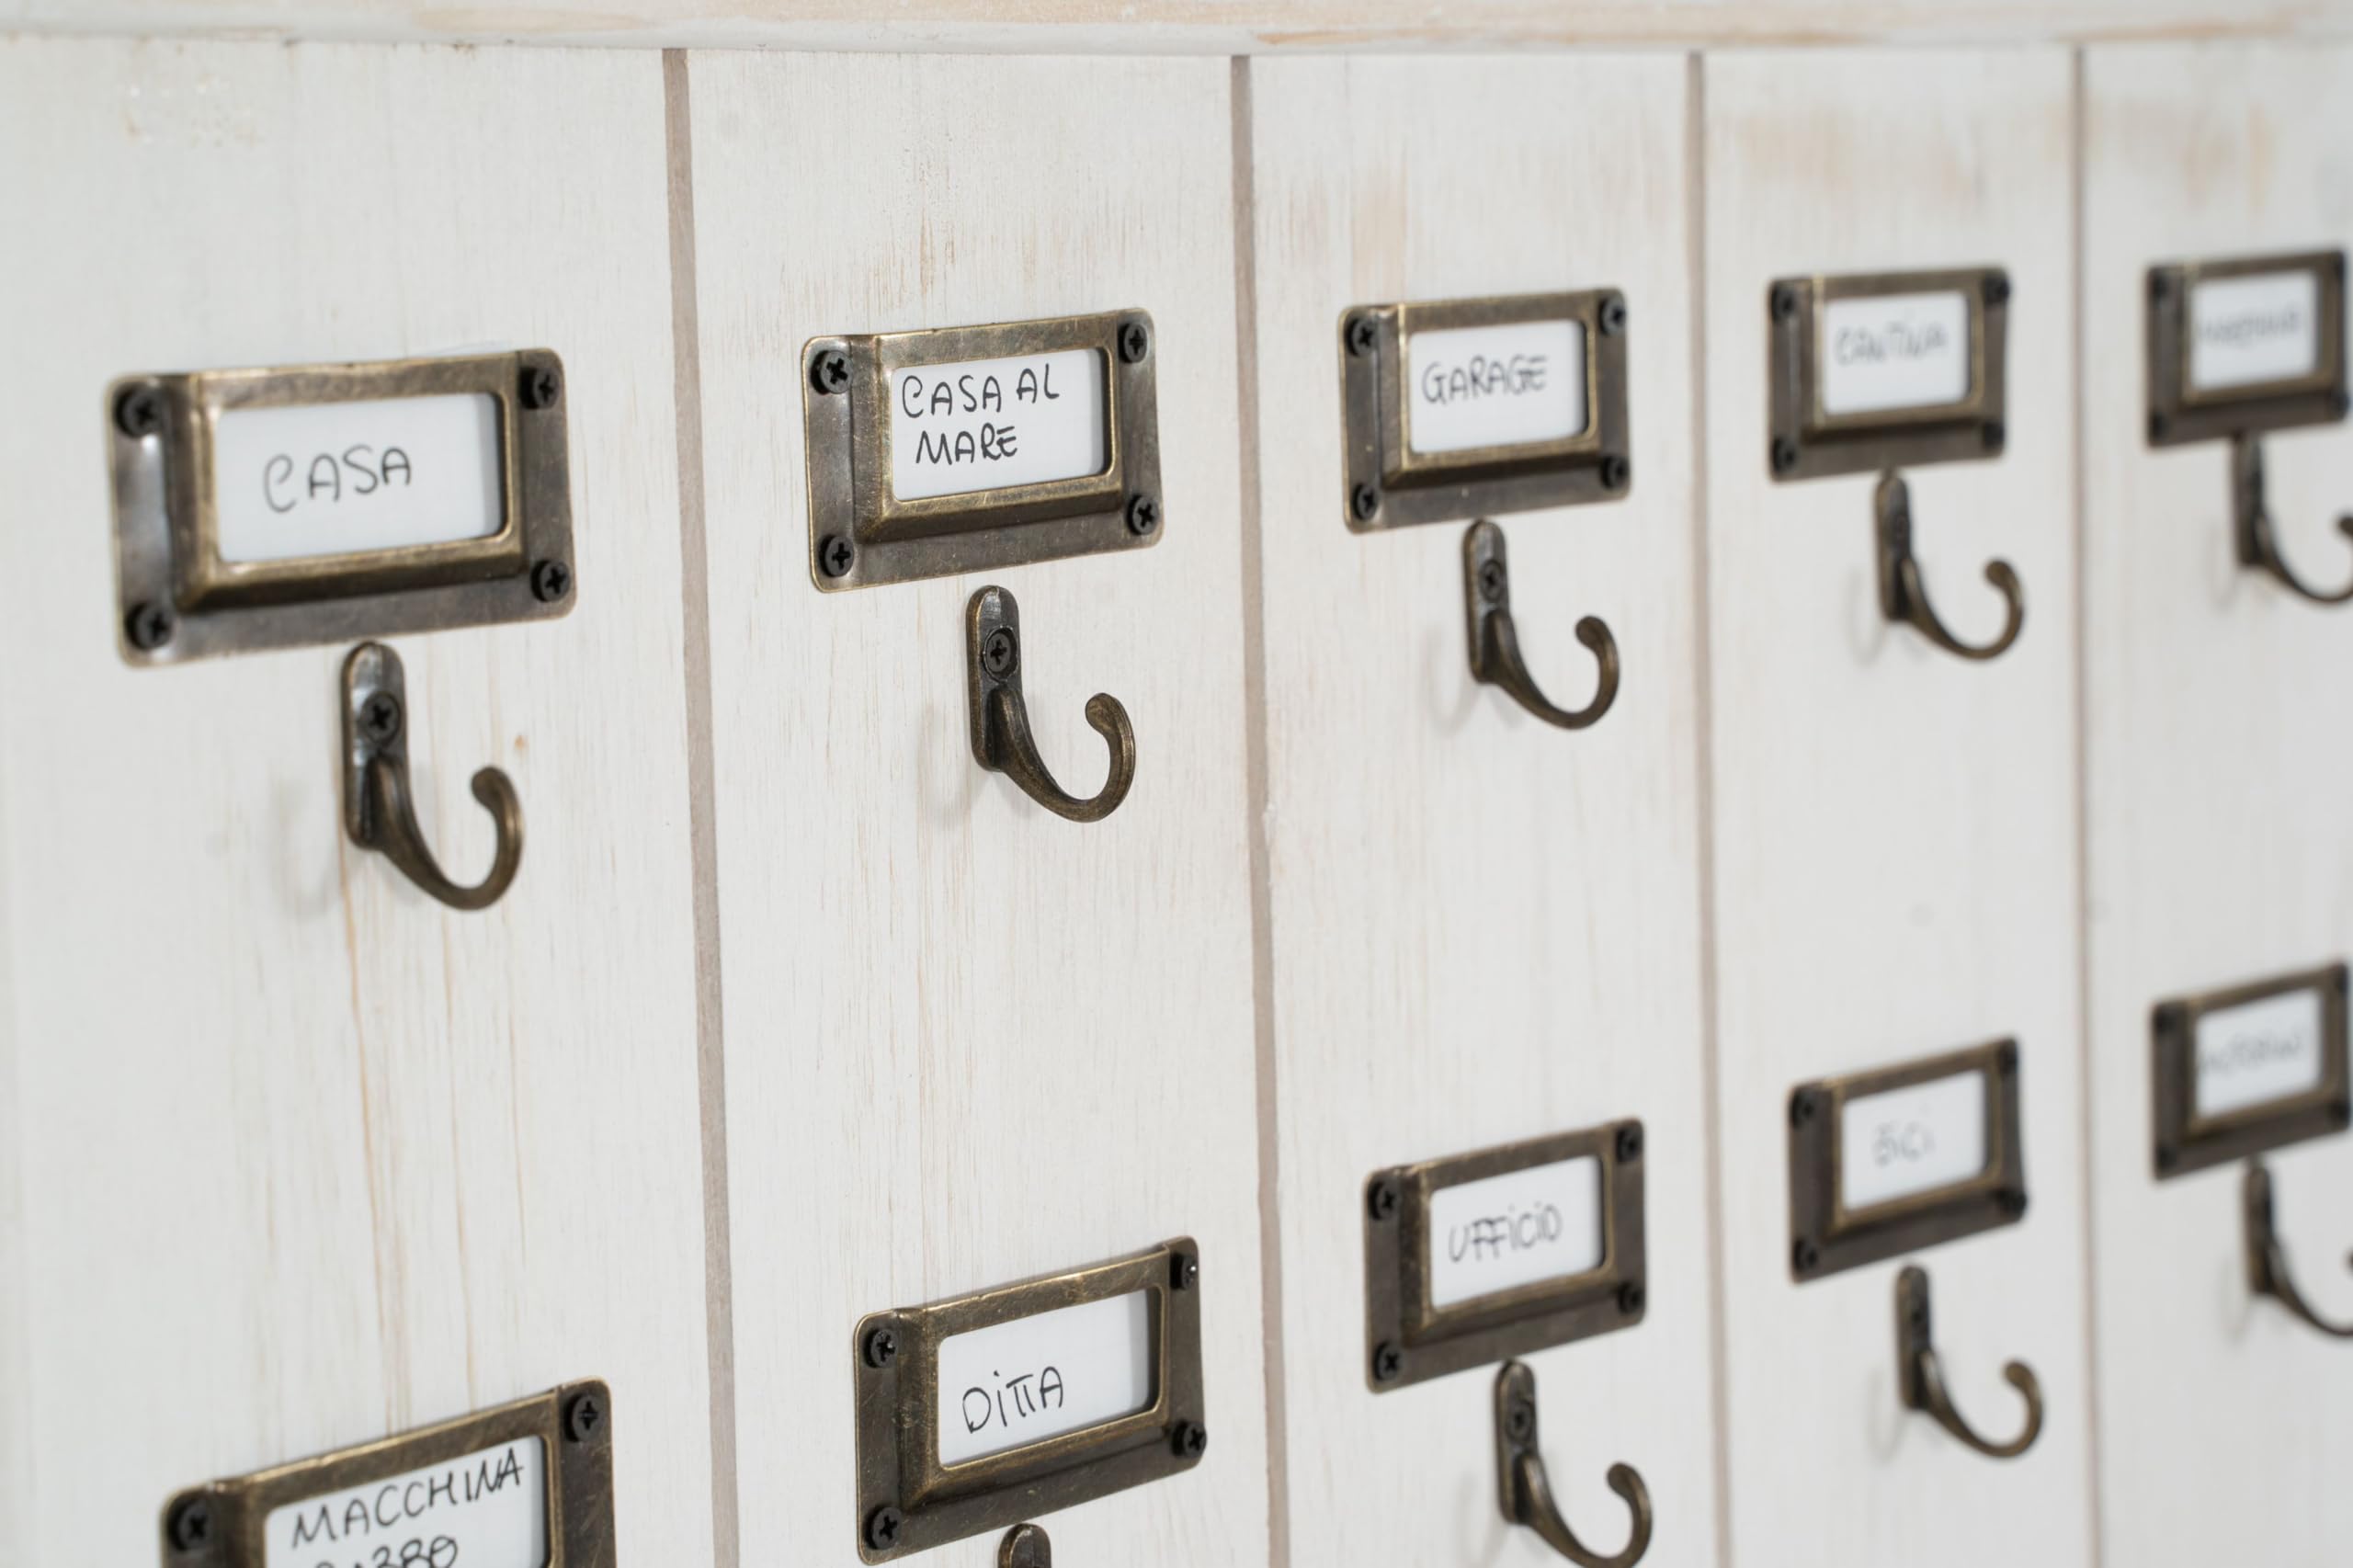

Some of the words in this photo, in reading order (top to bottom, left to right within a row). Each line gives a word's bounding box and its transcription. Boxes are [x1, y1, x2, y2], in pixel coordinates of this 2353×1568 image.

[902, 375, 1002, 418] CASA
[1016, 363, 1060, 404] AL
[1421, 354, 1547, 405] GARAGE
[915, 422, 1017, 465] MARE
[263, 444, 412, 515] CASA
[292, 1448, 524, 1550] MACCHINA
